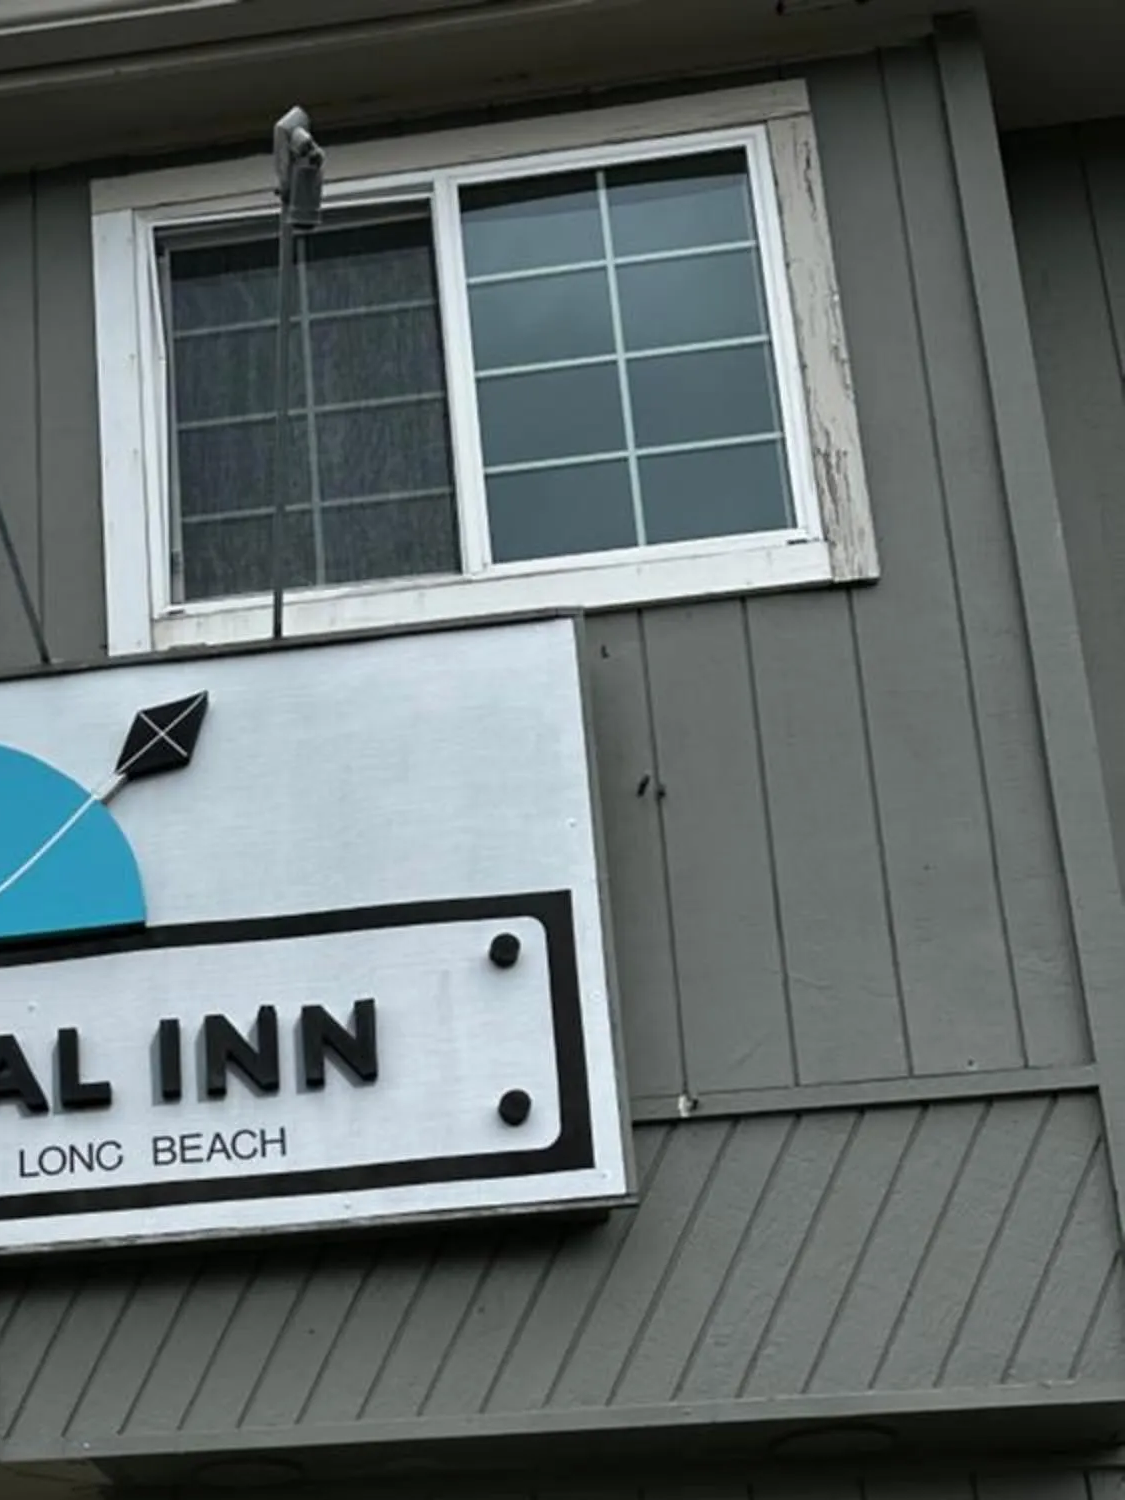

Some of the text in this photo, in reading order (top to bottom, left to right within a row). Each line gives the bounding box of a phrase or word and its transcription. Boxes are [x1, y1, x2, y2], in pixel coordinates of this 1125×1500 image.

[159, 998, 378, 1102] INN
[19, 1140, 124, 1178] LONG
[151, 1126, 287, 1167] BEACH
